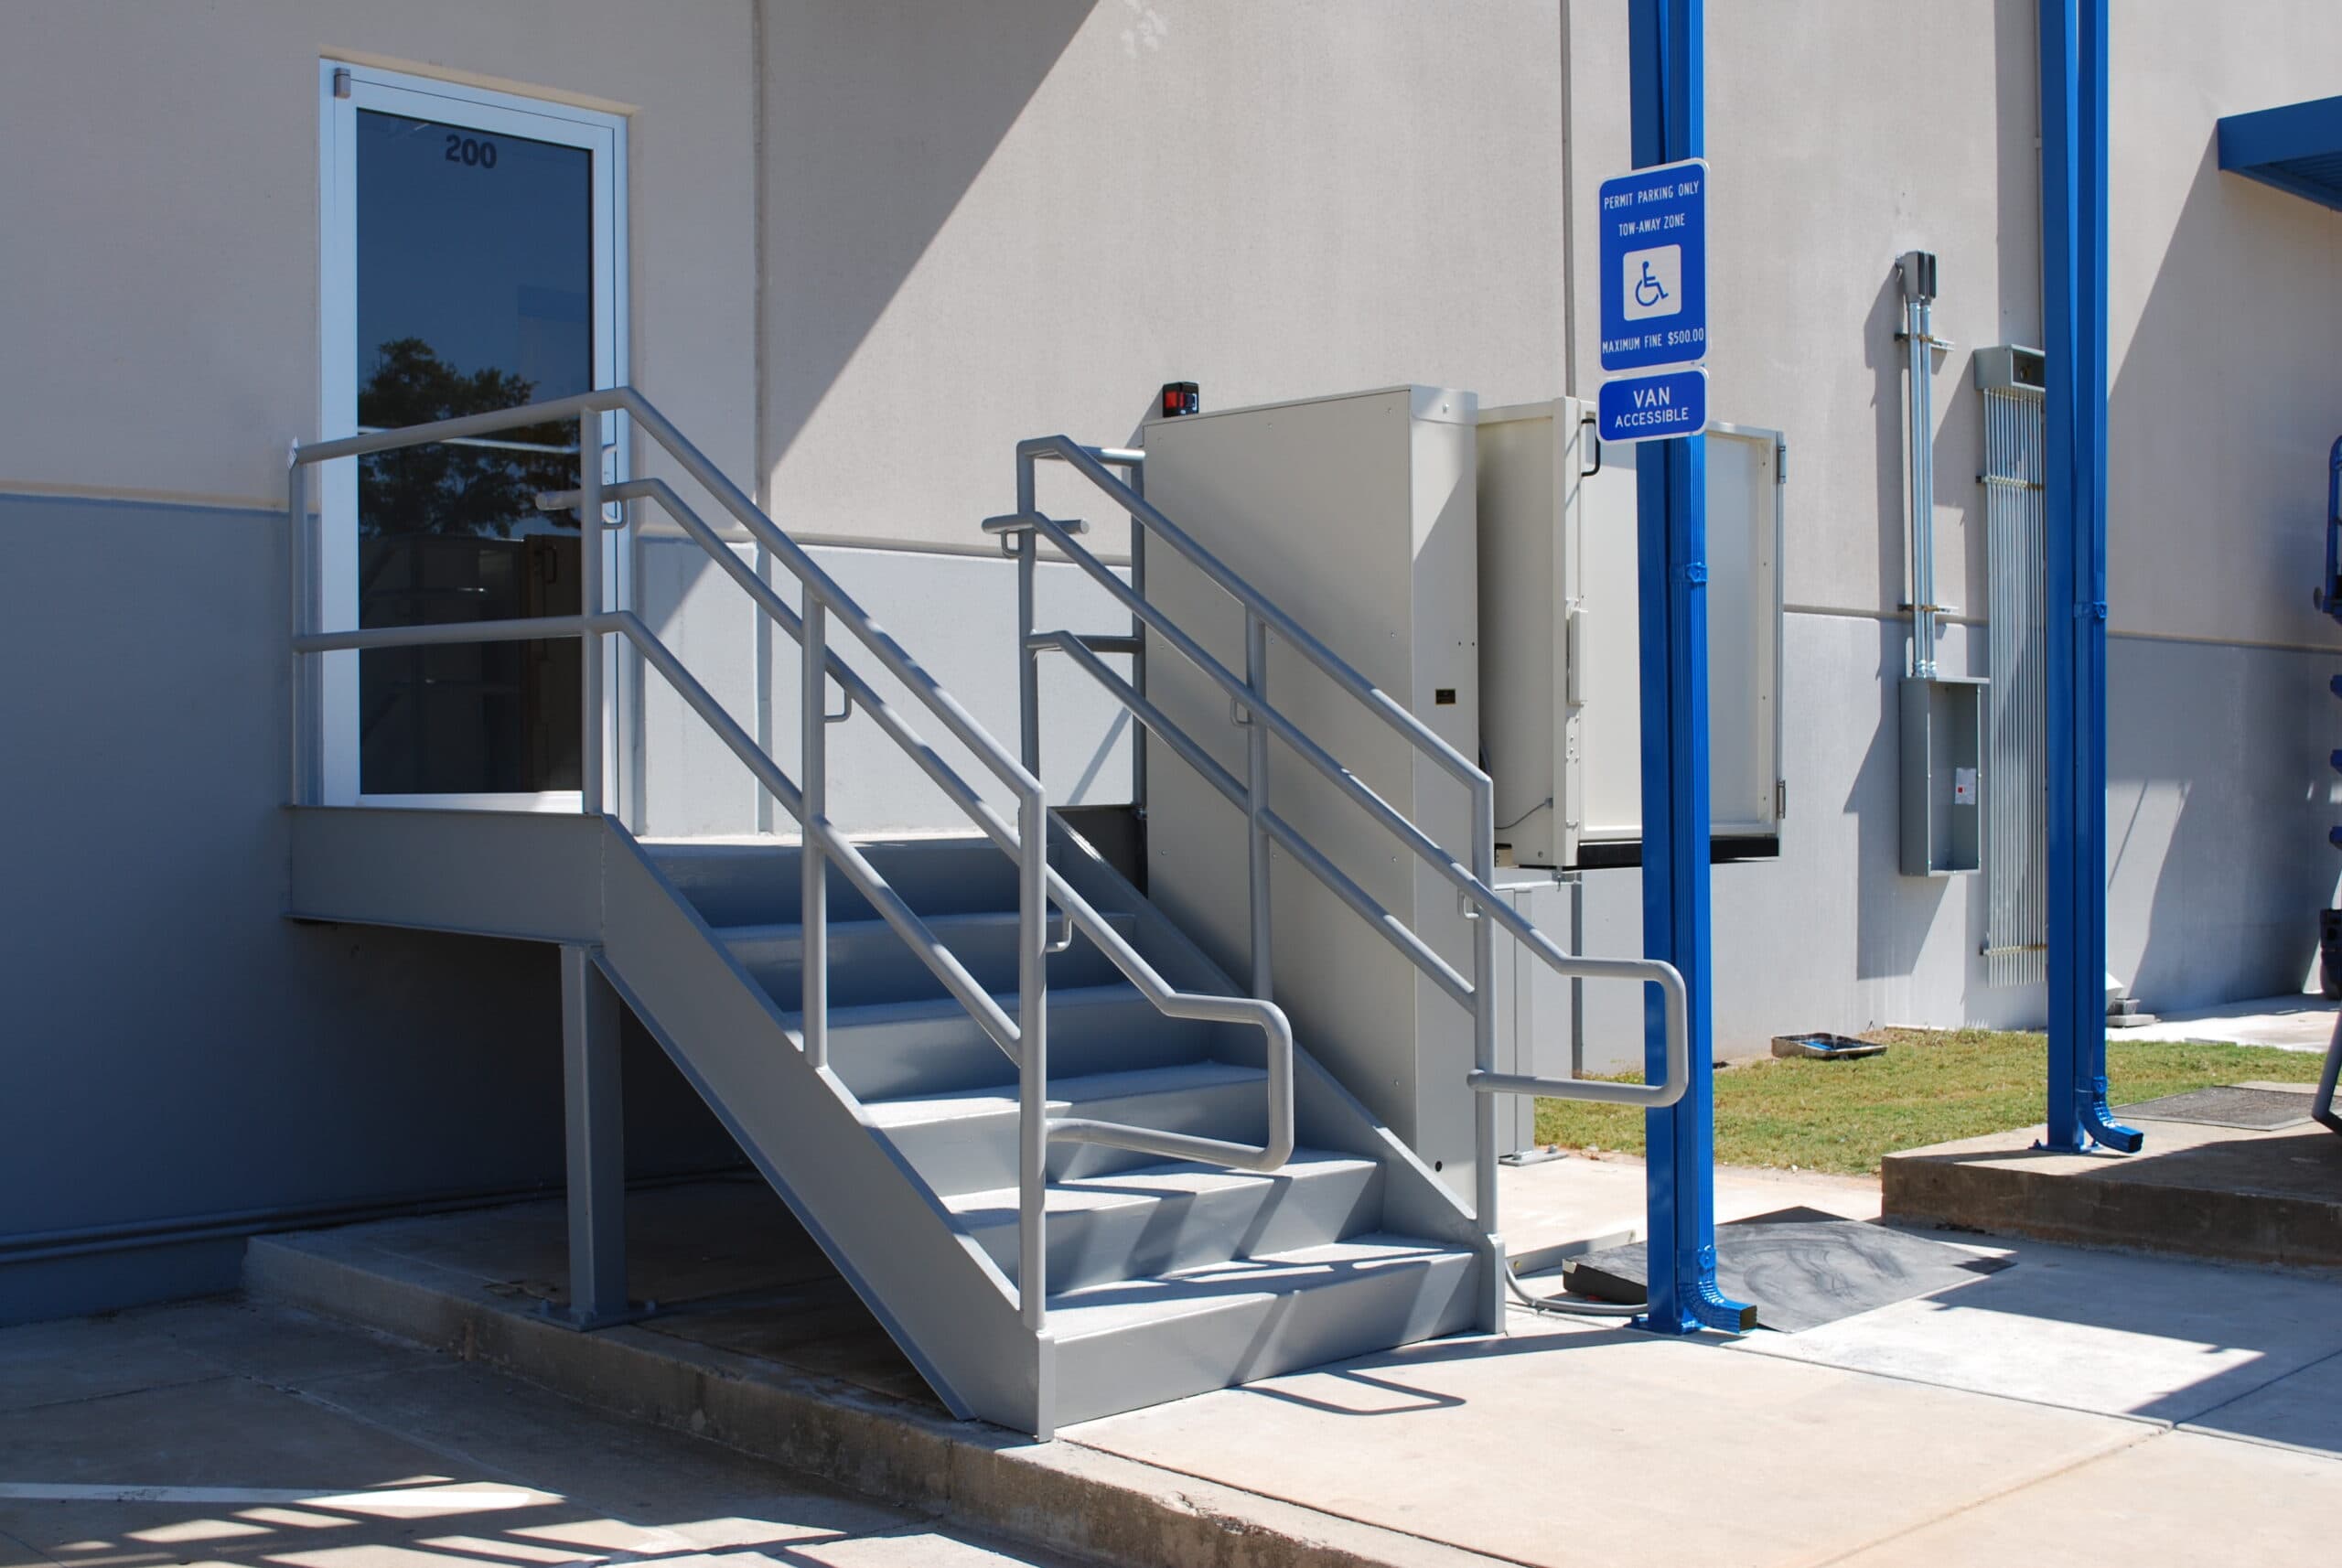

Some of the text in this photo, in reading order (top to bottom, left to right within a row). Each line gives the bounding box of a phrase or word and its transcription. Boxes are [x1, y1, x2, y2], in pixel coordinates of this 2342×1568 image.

[445, 134, 498, 169] 200
[1604, 180, 1700, 210] PERMIT PARKING ONLY
[1618, 213, 1685, 237] TOW-AWAY ZONE
[1602, 327, 1704, 354] MAXIMUM FINE $500.00
[1633, 386, 1671, 409] VAN
[1615, 407, 1689, 428] ACCESSIBLE
